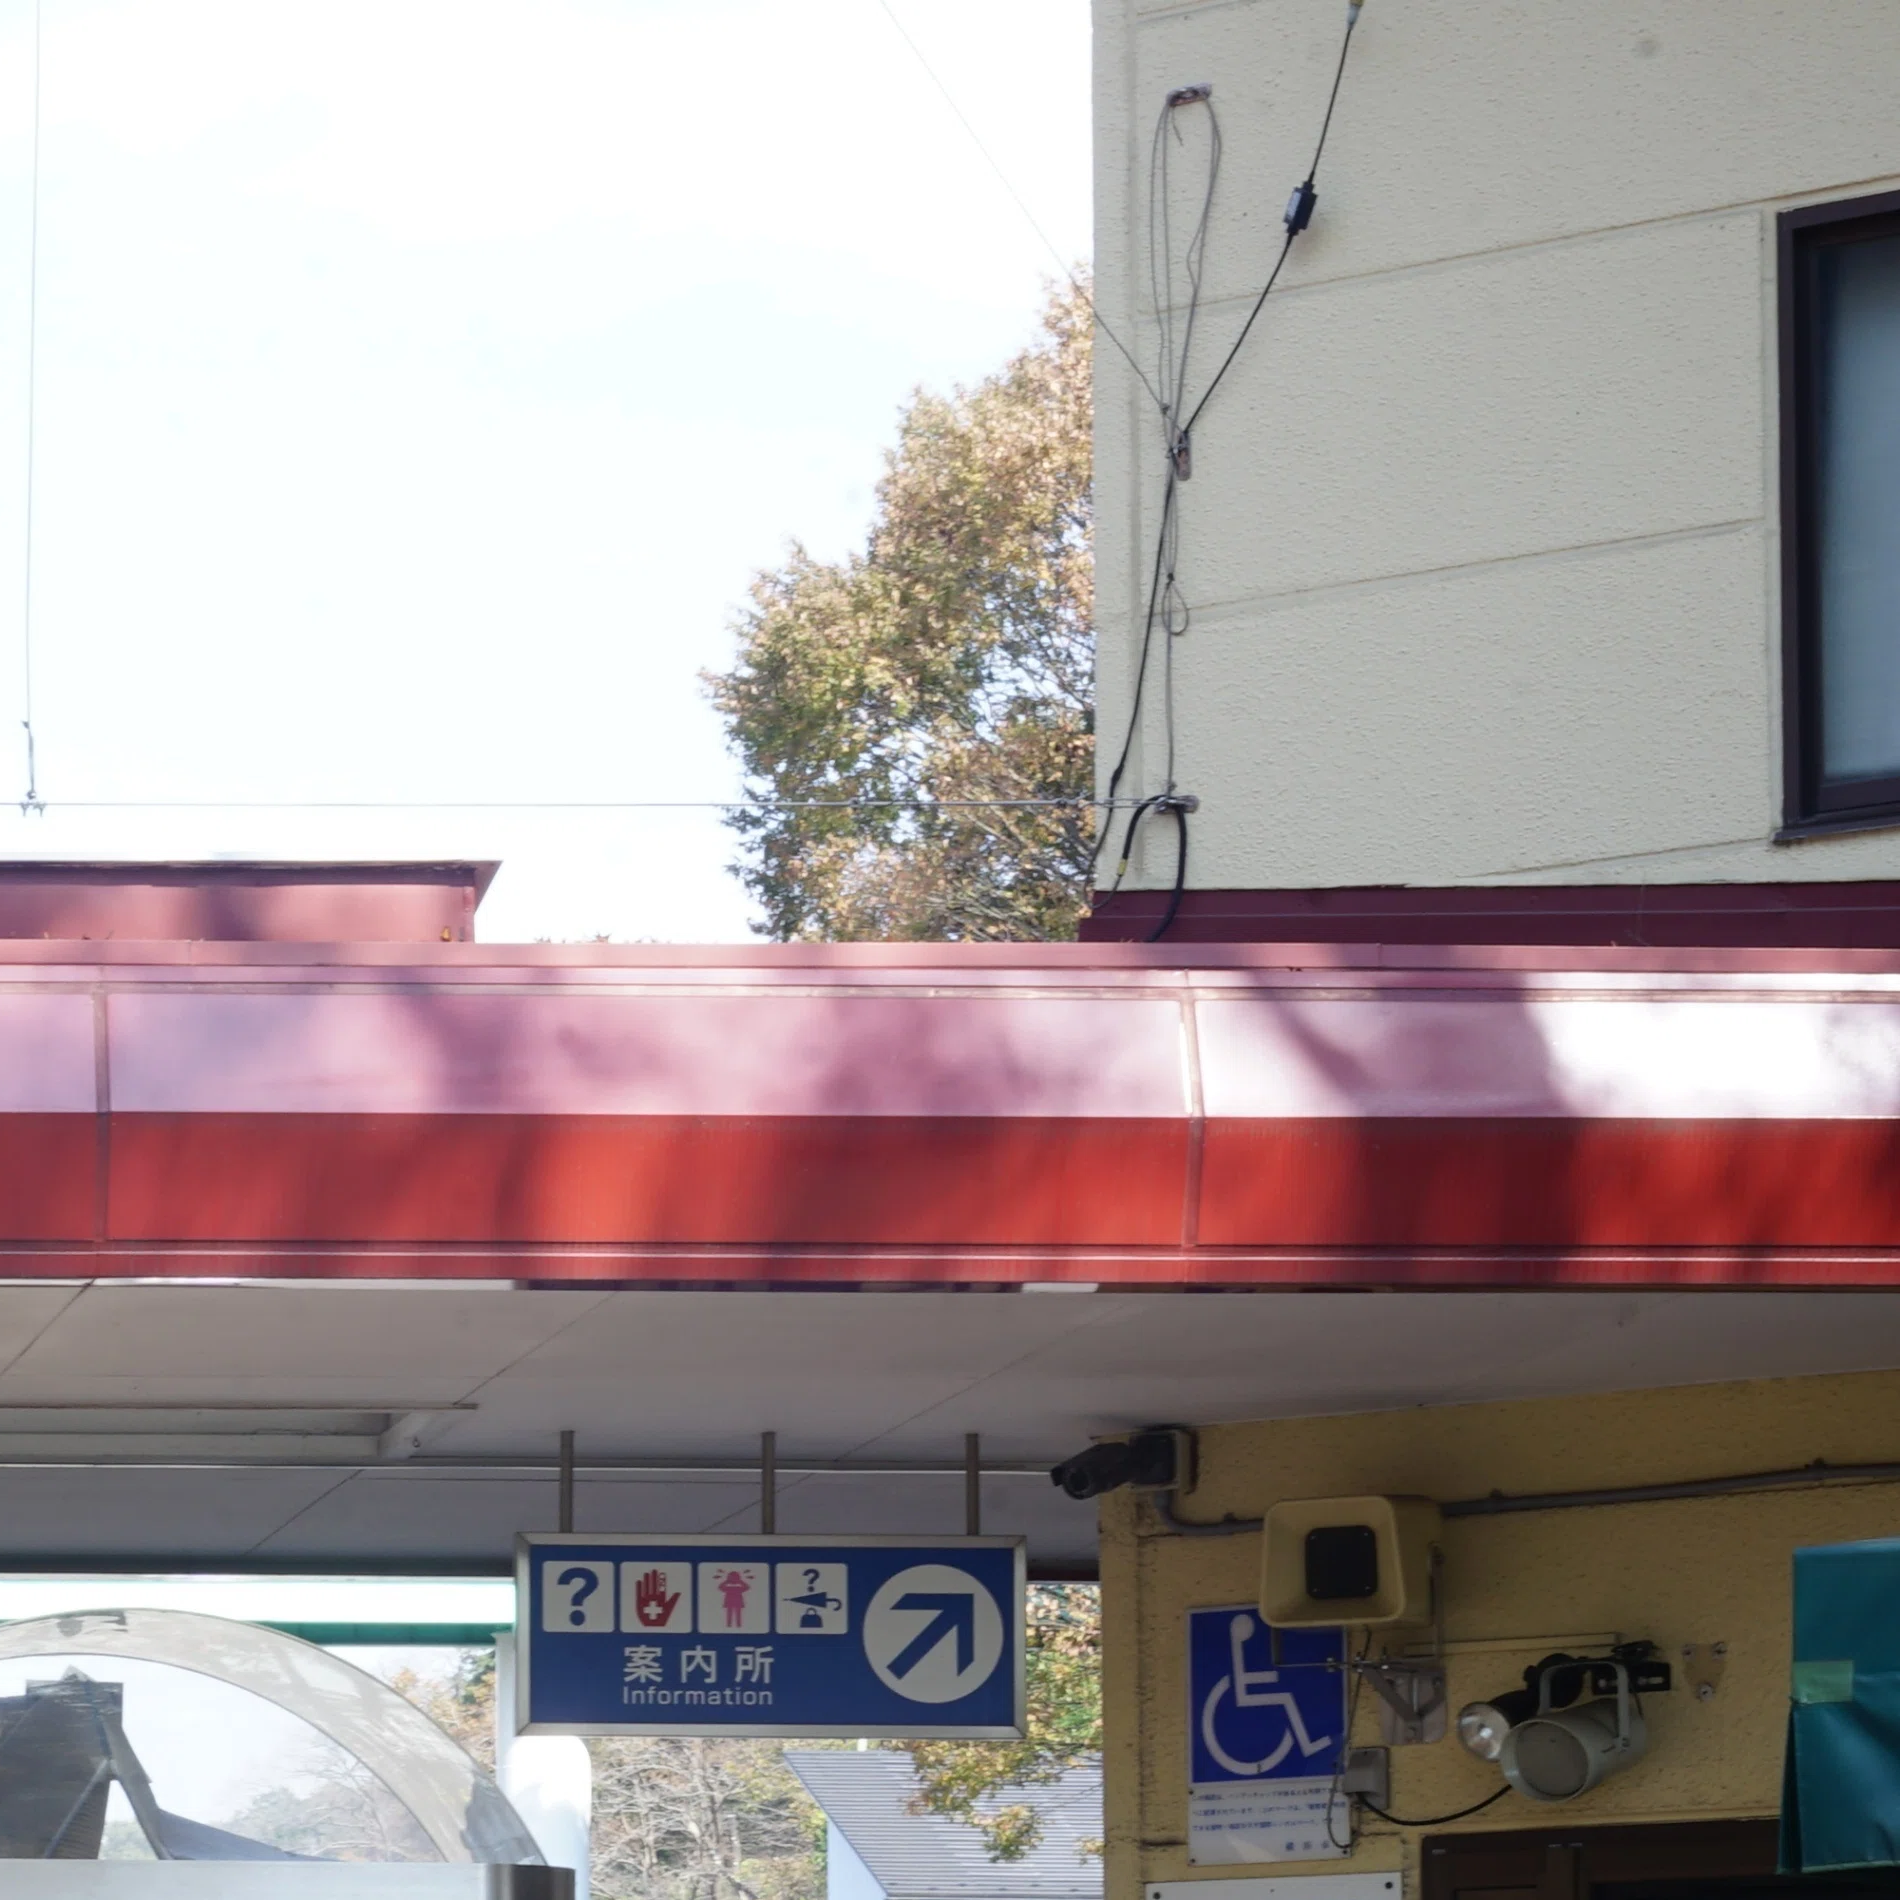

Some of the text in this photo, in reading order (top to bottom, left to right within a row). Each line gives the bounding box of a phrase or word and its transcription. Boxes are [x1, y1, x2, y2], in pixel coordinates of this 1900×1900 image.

[622, 1644, 774, 1684] 案内所
[622, 1684, 774, 1706] Information
